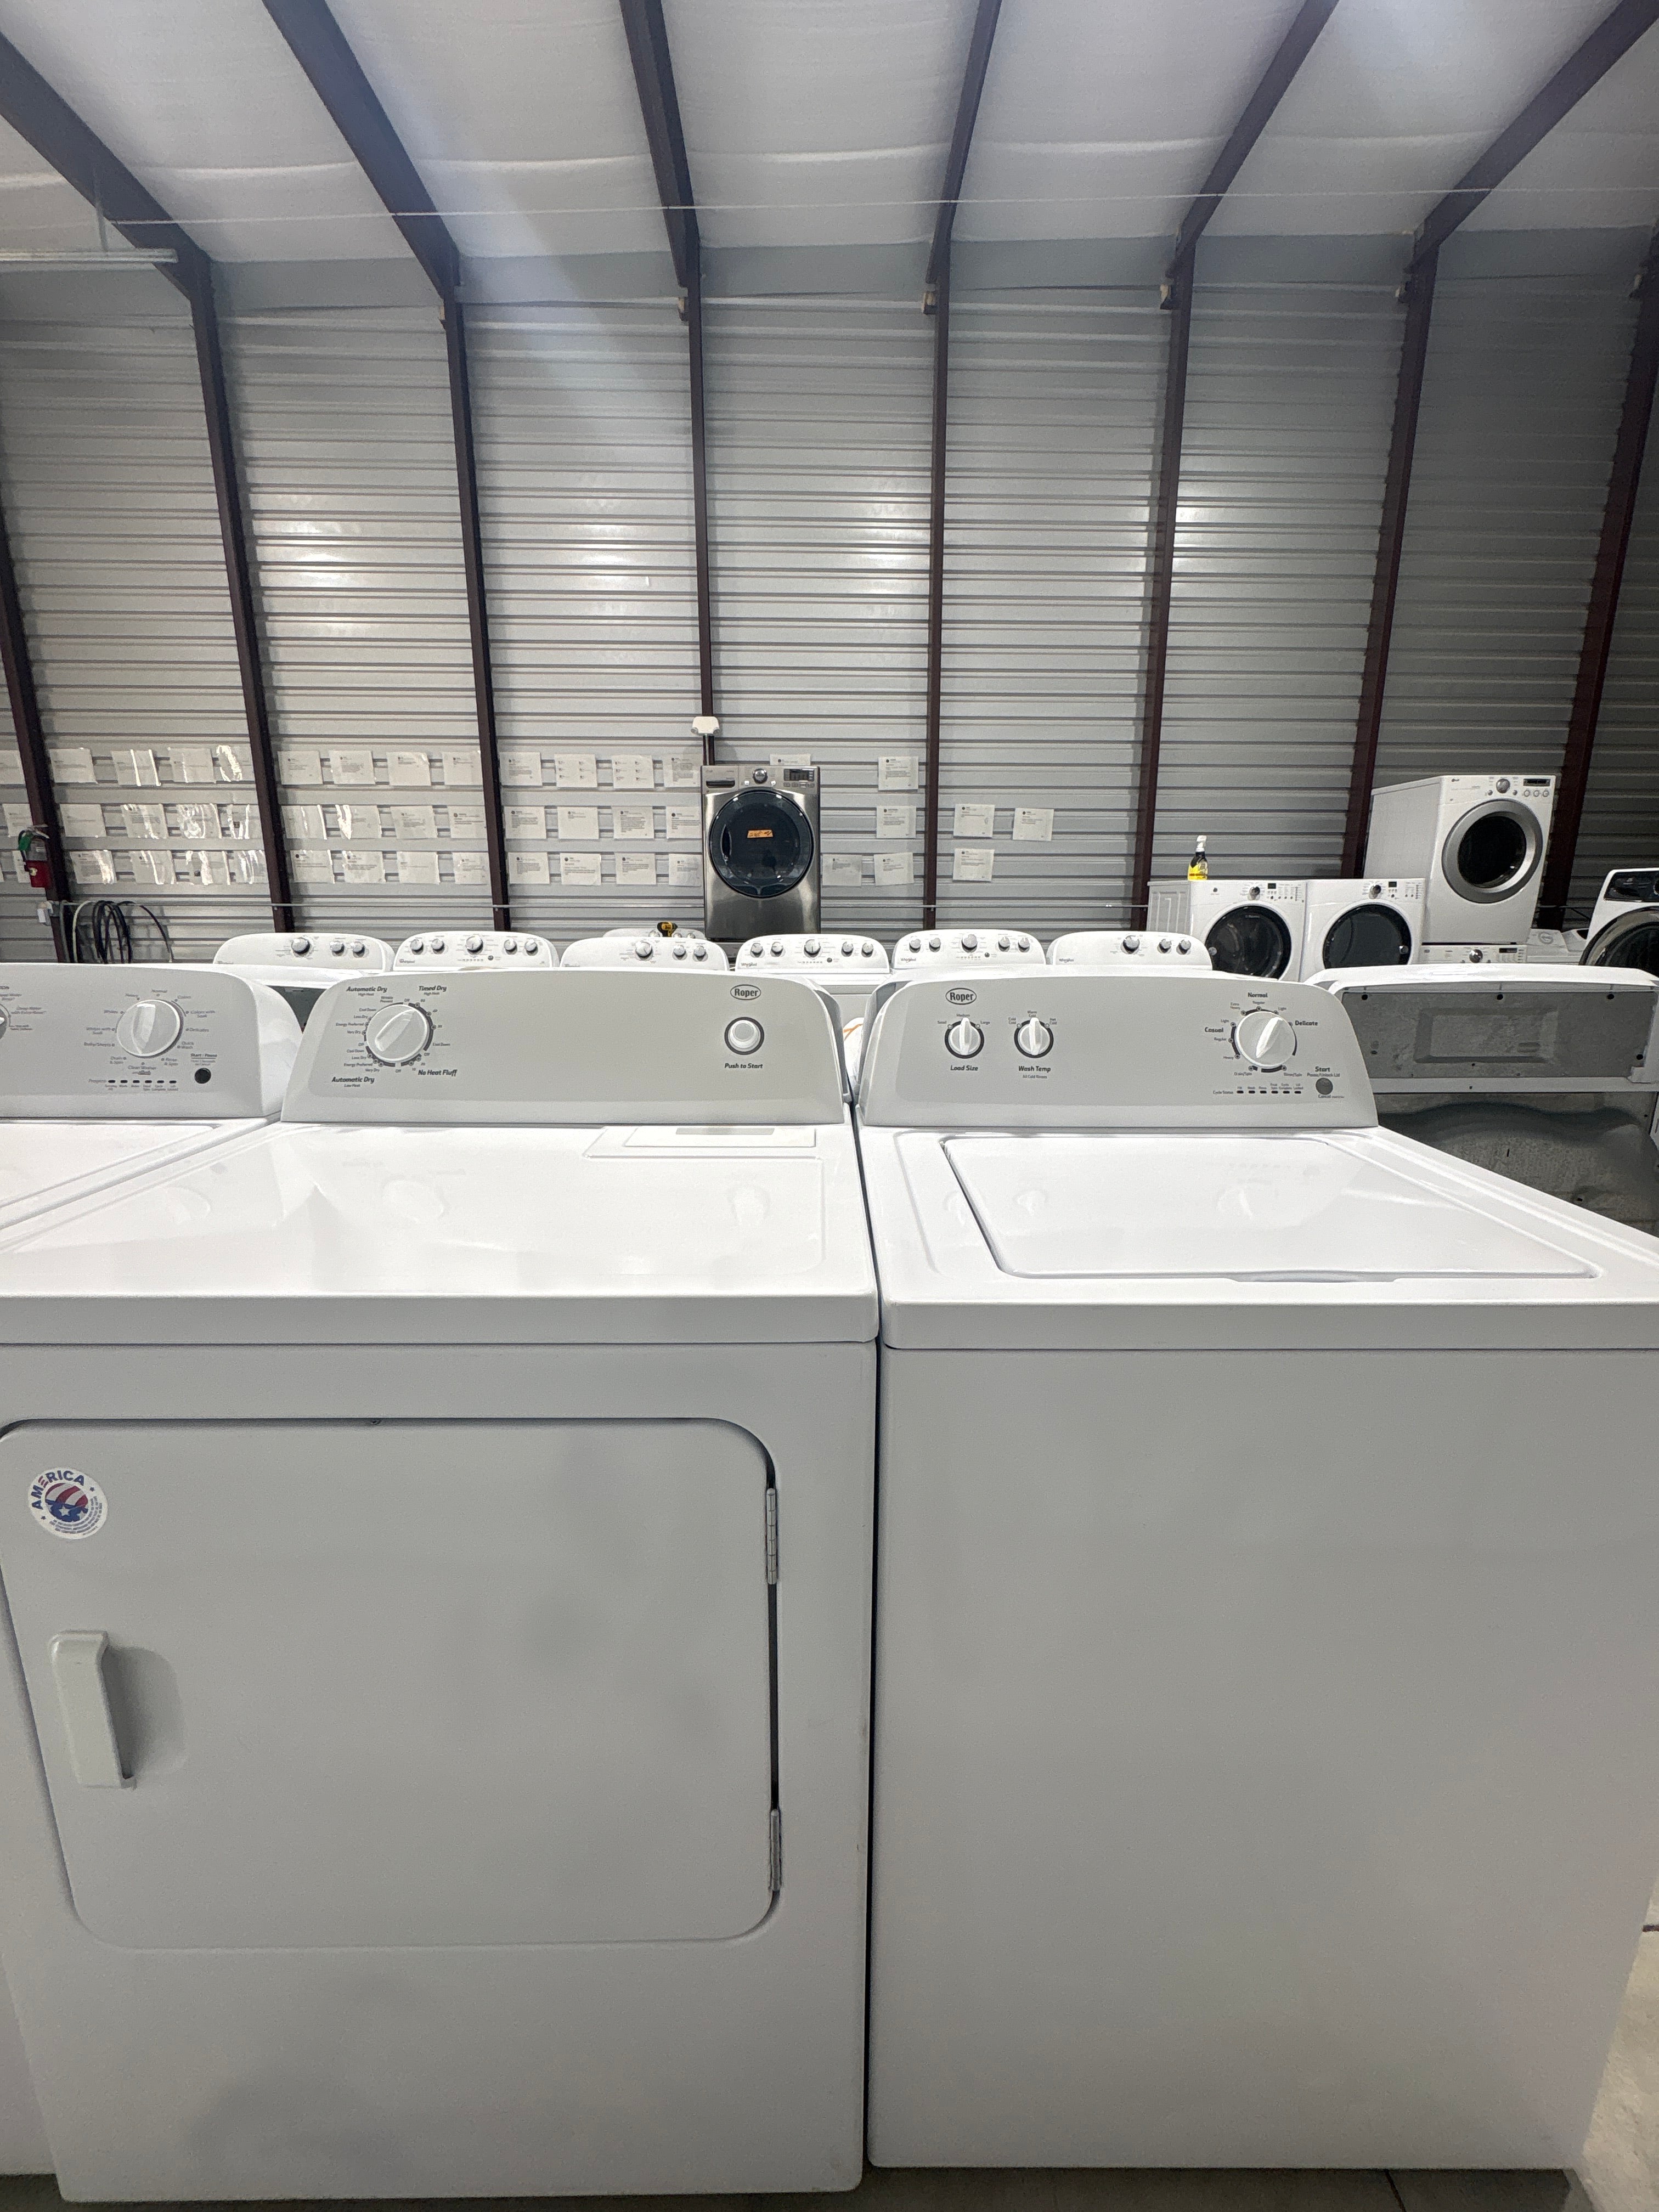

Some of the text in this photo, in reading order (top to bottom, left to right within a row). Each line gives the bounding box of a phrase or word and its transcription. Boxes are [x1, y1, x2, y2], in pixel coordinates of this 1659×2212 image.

[734, 988, 758, 997] Roper
[950, 992, 974, 1002] Roper
[31, 1470, 84, 1510] AMERICA
